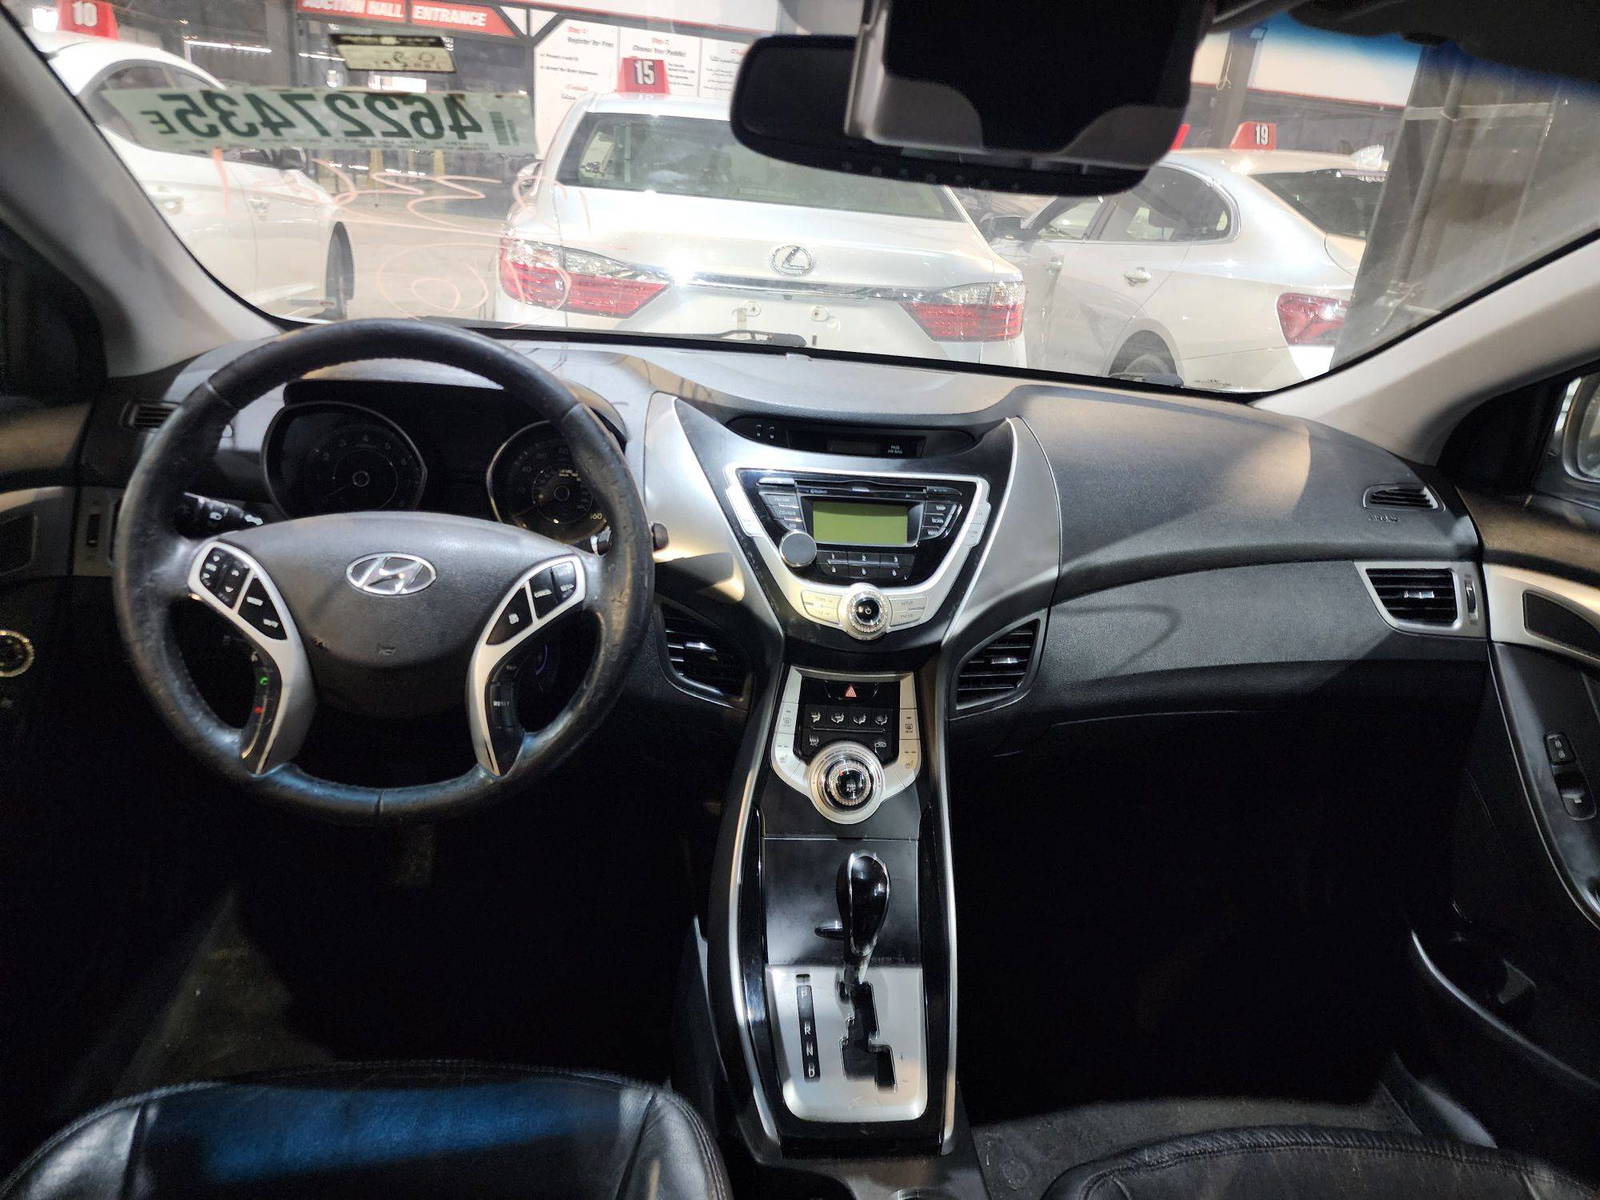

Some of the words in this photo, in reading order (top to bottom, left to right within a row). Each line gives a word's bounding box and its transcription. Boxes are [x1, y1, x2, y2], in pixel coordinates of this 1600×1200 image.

[413, 5, 488, 27] ENTRANCE
[633, 59, 656, 85] 15
[1255, 124, 1269, 145] 19
[808, 1066, 816, 1078] D
